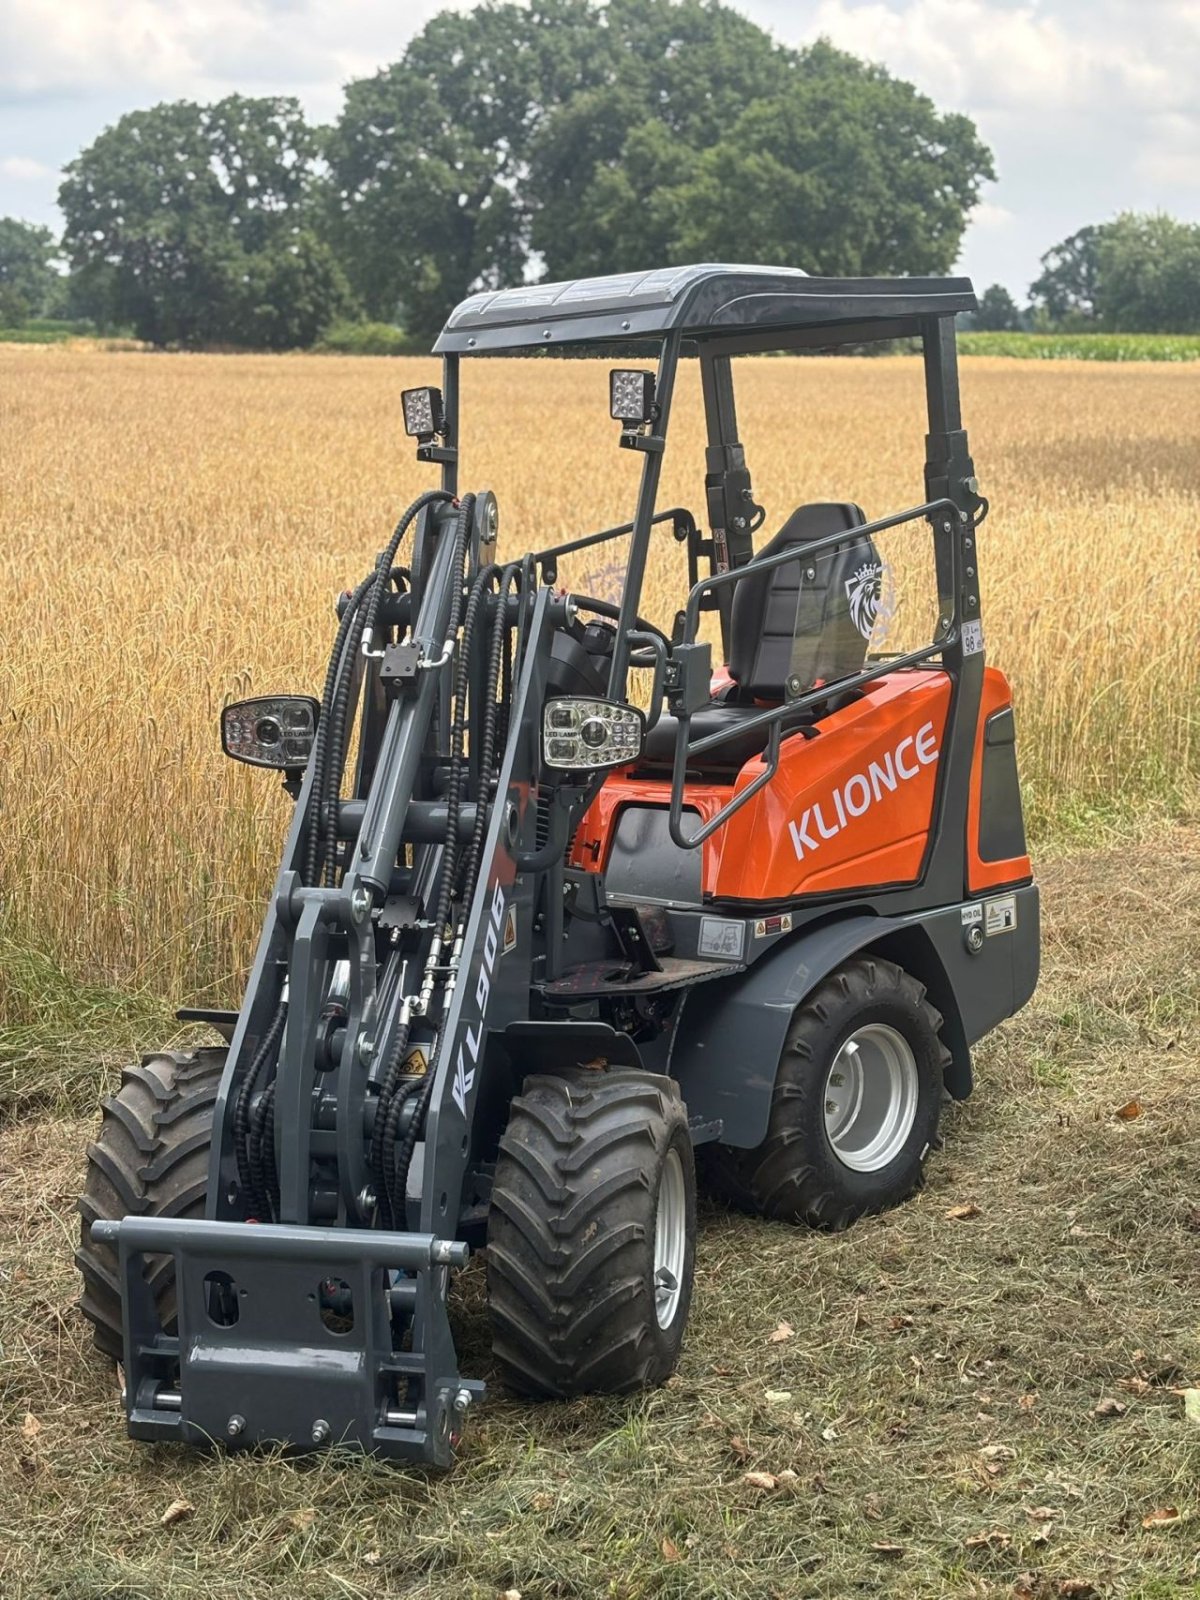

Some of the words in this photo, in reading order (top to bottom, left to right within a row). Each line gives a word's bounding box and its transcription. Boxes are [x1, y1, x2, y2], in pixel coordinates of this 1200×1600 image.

[787, 721, 939, 861] KLIONCE
[962, 911, 973, 919] HYD
[973, 908, 982, 917] OIL
